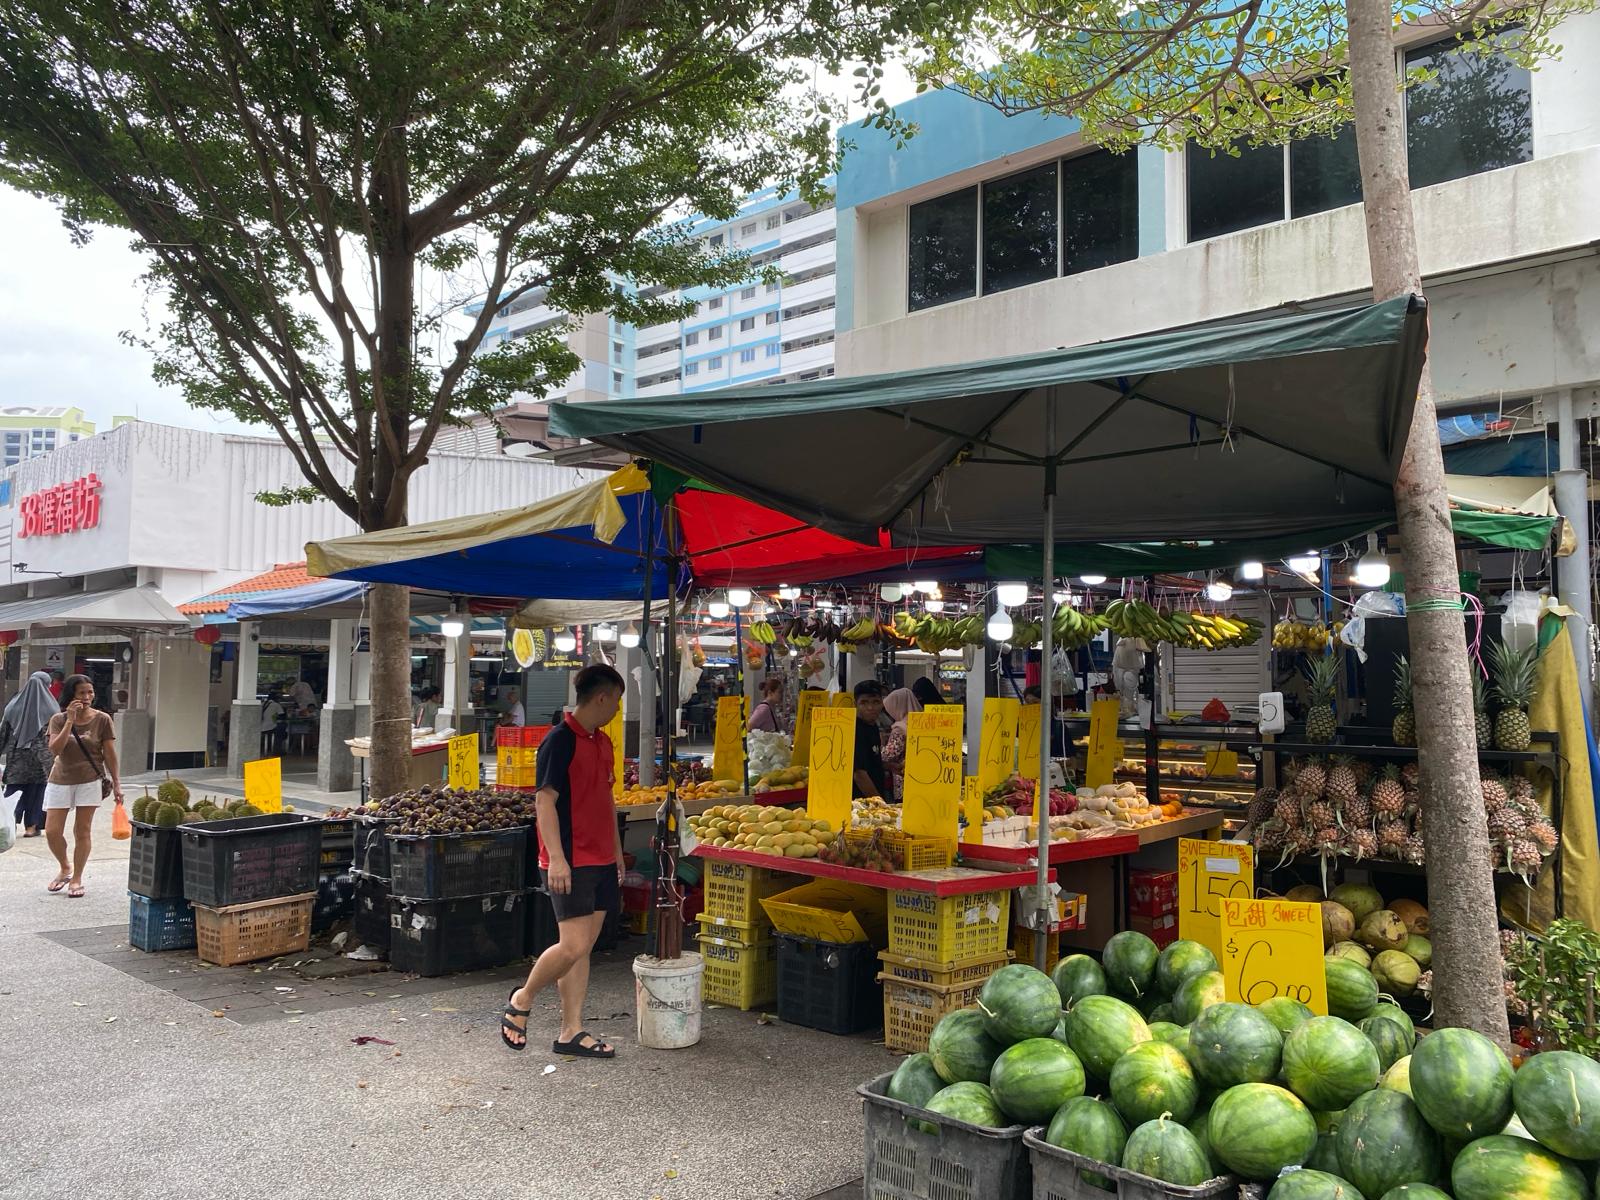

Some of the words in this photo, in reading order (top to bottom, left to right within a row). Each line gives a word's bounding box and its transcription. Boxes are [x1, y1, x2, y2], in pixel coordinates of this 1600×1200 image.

[814, 708, 846, 721] OFFER
[1262, 700, 1278, 722] 5
[452, 736, 475, 750] OFFER
